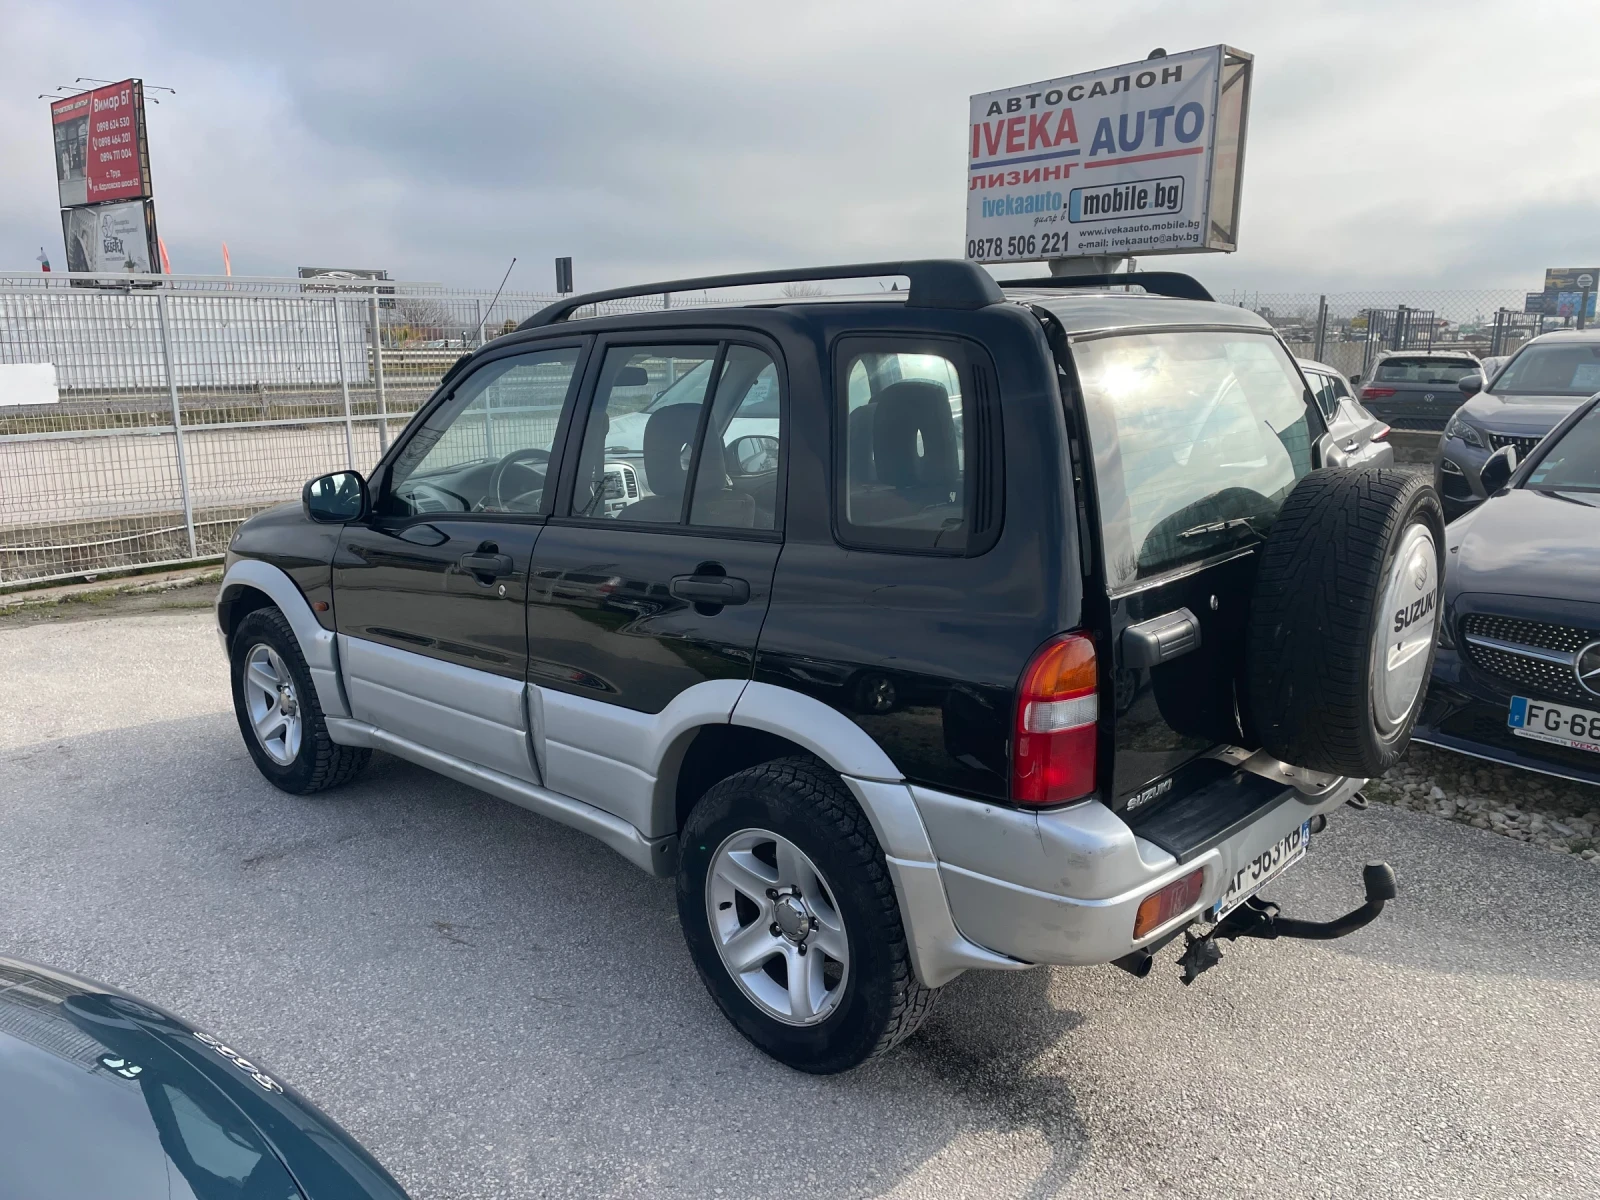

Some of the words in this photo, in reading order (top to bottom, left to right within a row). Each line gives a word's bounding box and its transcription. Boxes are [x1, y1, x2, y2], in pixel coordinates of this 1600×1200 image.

[94, 95, 119, 112] Вимар
[986, 65, 1183, 117] АВТОСАЛОН
[96, 121, 109, 132] 0898
[120, 116, 130, 127] 530
[121, 132, 131, 142] 201
[972, 107, 1079, 159] IVEKA
[1088, 101, 1205, 156] AUTO
[969, 162, 1080, 191] ЛИЗИНГ
[1083, 182, 1180, 216] mobile.bg
[1078, 239, 1109, 249] e-mail:
[1111, 232, 1199, 247] ivekaauto@abv.bg
[1079, 219, 1200, 237] www.ivekaauto.mobile.bg
[968, 237, 1003, 259] 0878
[1007, 234, 1036, 256] 506
[1040, 231, 1069, 253] 221
[1394, 588, 1436, 633] SUZUKI
[1570, 741, 1600, 752] IVEKA
[1126, 777, 1173, 811] SUZUKI
